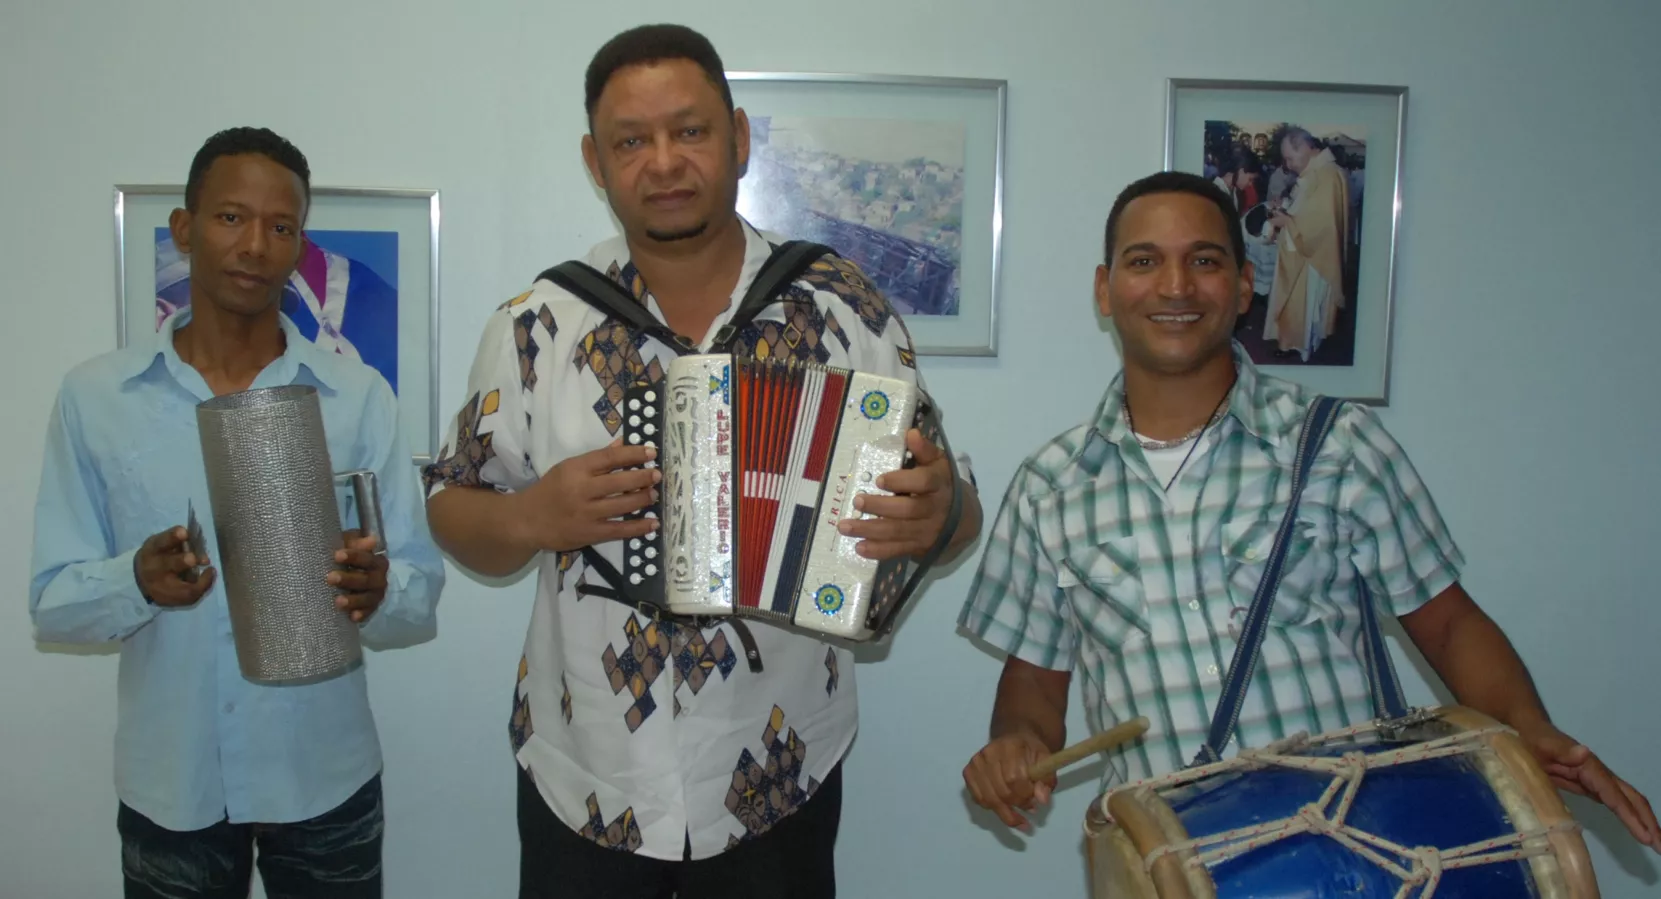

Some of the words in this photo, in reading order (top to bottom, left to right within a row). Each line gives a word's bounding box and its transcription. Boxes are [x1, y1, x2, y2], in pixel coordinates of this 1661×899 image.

[717, 409, 729, 456] LUPE
[717, 471, 730, 554] VALERIO
[828, 475, 848, 526] ERICA
